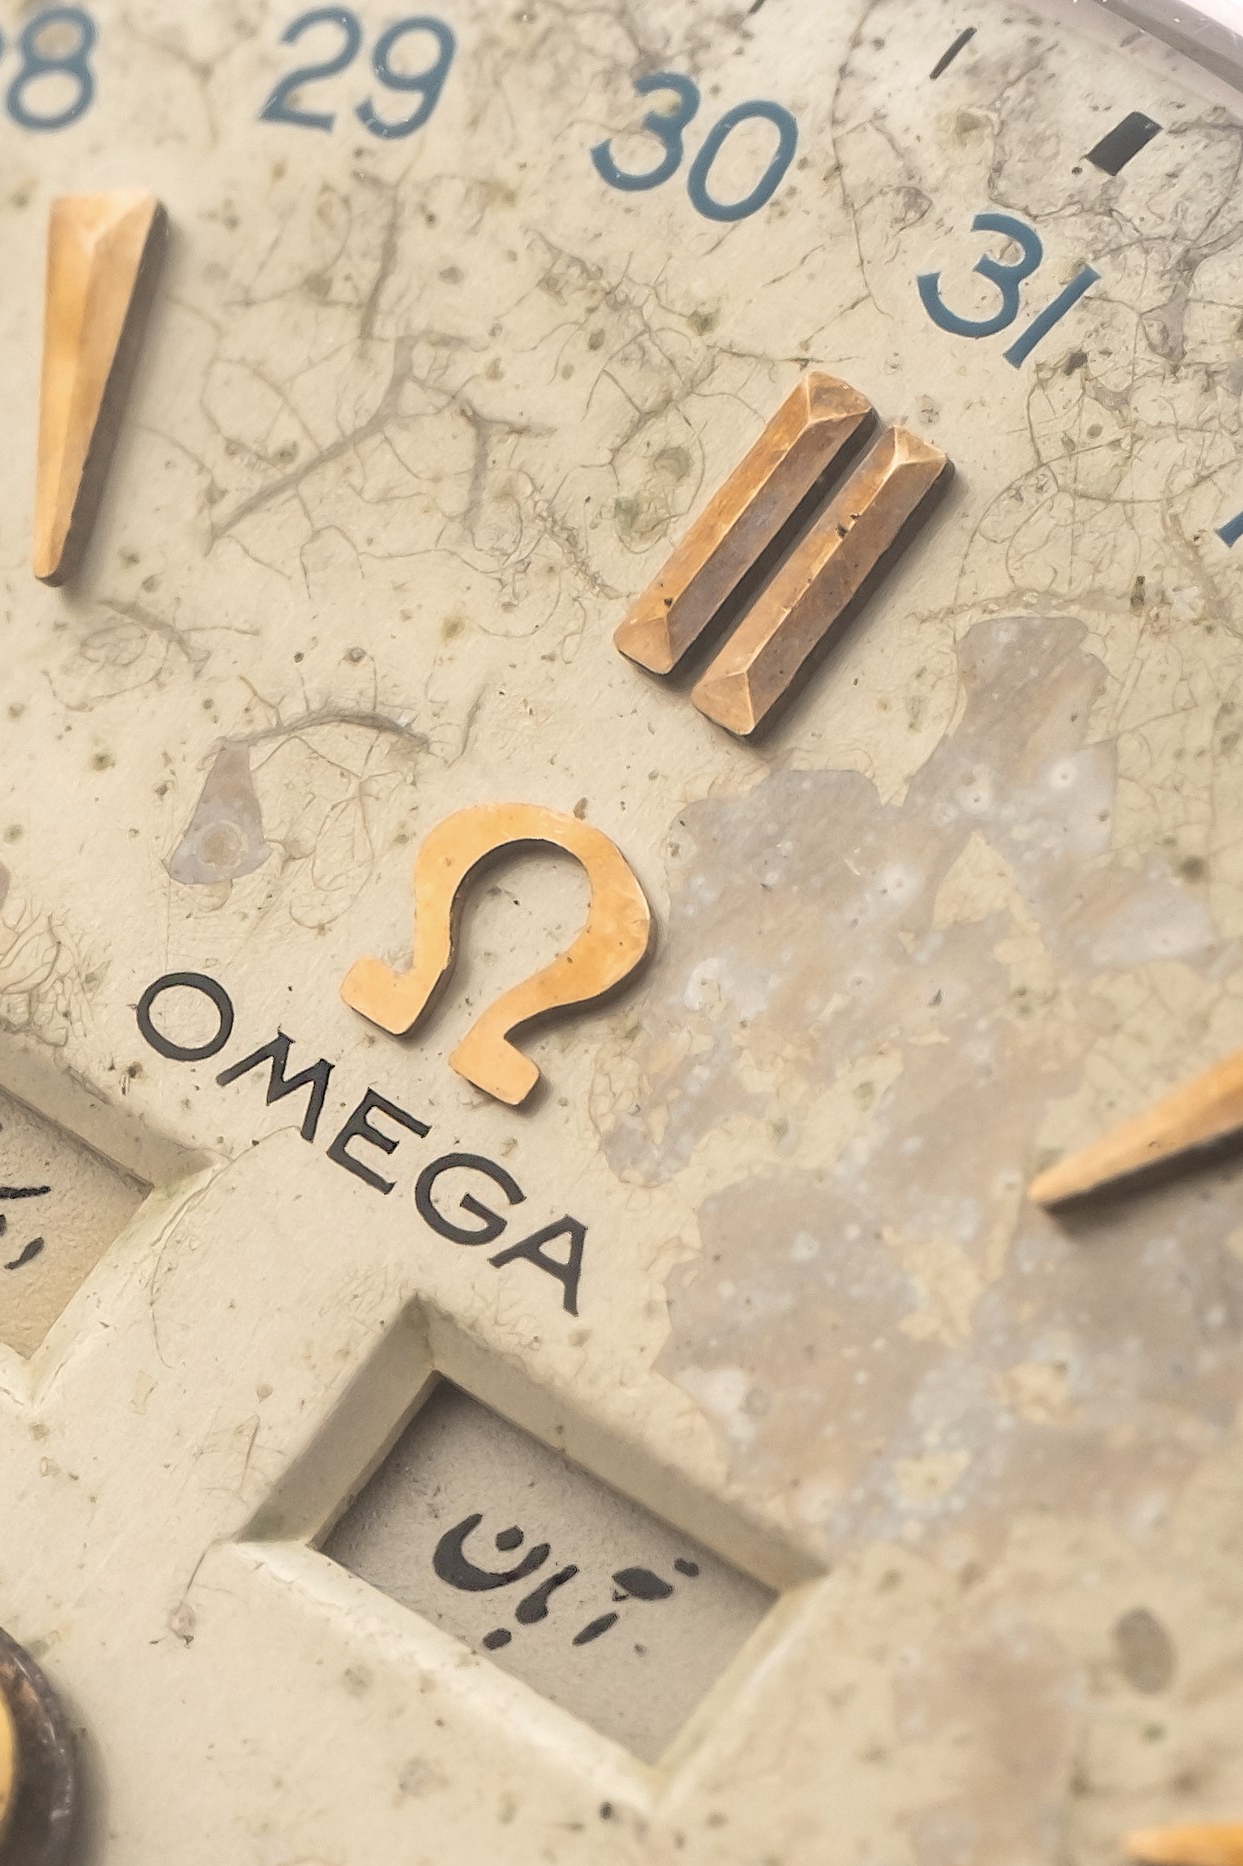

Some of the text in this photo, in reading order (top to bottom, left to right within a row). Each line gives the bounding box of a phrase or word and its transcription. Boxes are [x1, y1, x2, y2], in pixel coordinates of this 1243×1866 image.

[260, 3, 459, 140] 29
[589, 69, 801, 223] 30
[915, 210, 1102, 368] 31
[136, 970, 589, 1317] OMEGA
